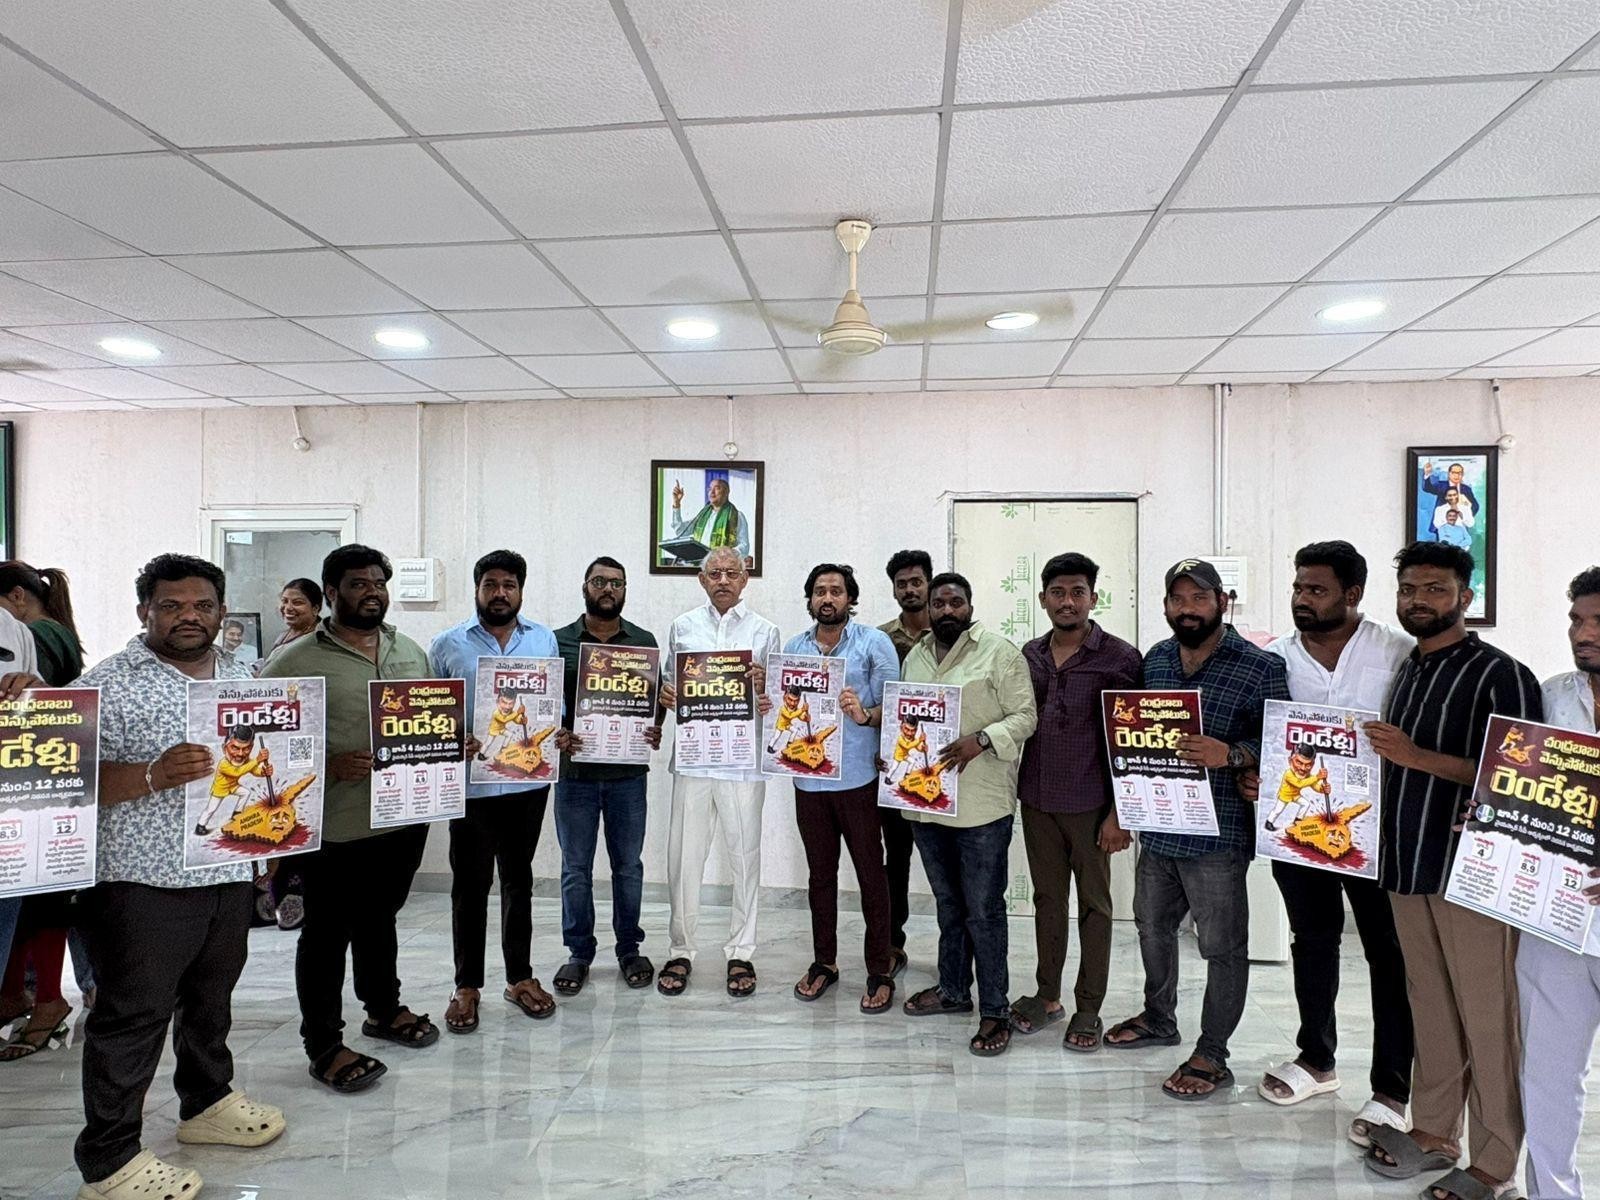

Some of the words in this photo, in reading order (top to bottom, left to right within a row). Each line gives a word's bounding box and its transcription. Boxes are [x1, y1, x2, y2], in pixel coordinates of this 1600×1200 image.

[496, 674, 545, 693] రెండేళ్లు
[586, 672, 649, 698] రెండేళ్లు
[683, 676, 746, 701] రెండేళ్లు
[783, 672, 828, 692] రెండేళ్లు
[218, 688, 284, 701] వెన్నుపోటుకు
[221, 702, 298, 730] రెండేళ్లు
[901, 701, 943, 722] రెండేళ్లు
[1288, 710, 1342, 724] వెన్నుపోటుకు
[381, 710, 456, 740] రెండేళ్లు
[408, 744, 413, 752] 4
[433, 742, 442, 750] 12
[1289, 726, 1355, 756] రెండేళ్లు
[1544, 736, 1600, 759] చంద్రబాబు
[1168, 758, 1178, 766] 12
[35, 779, 52, 790] 12
[1490, 764, 1598, 829] రెండేళ్లు
[56, 826, 72, 834] 12
[1497, 809, 1519, 821] జూన్
[1521, 814, 1529, 824] 4
[1530, 817, 1555, 832] నుంచి
[1556, 824, 1570, 837] 12
[1572, 830, 1596, 846] వరకు
[1478, 849, 1484, 857] 4
[1564, 878, 1578, 890] 12
